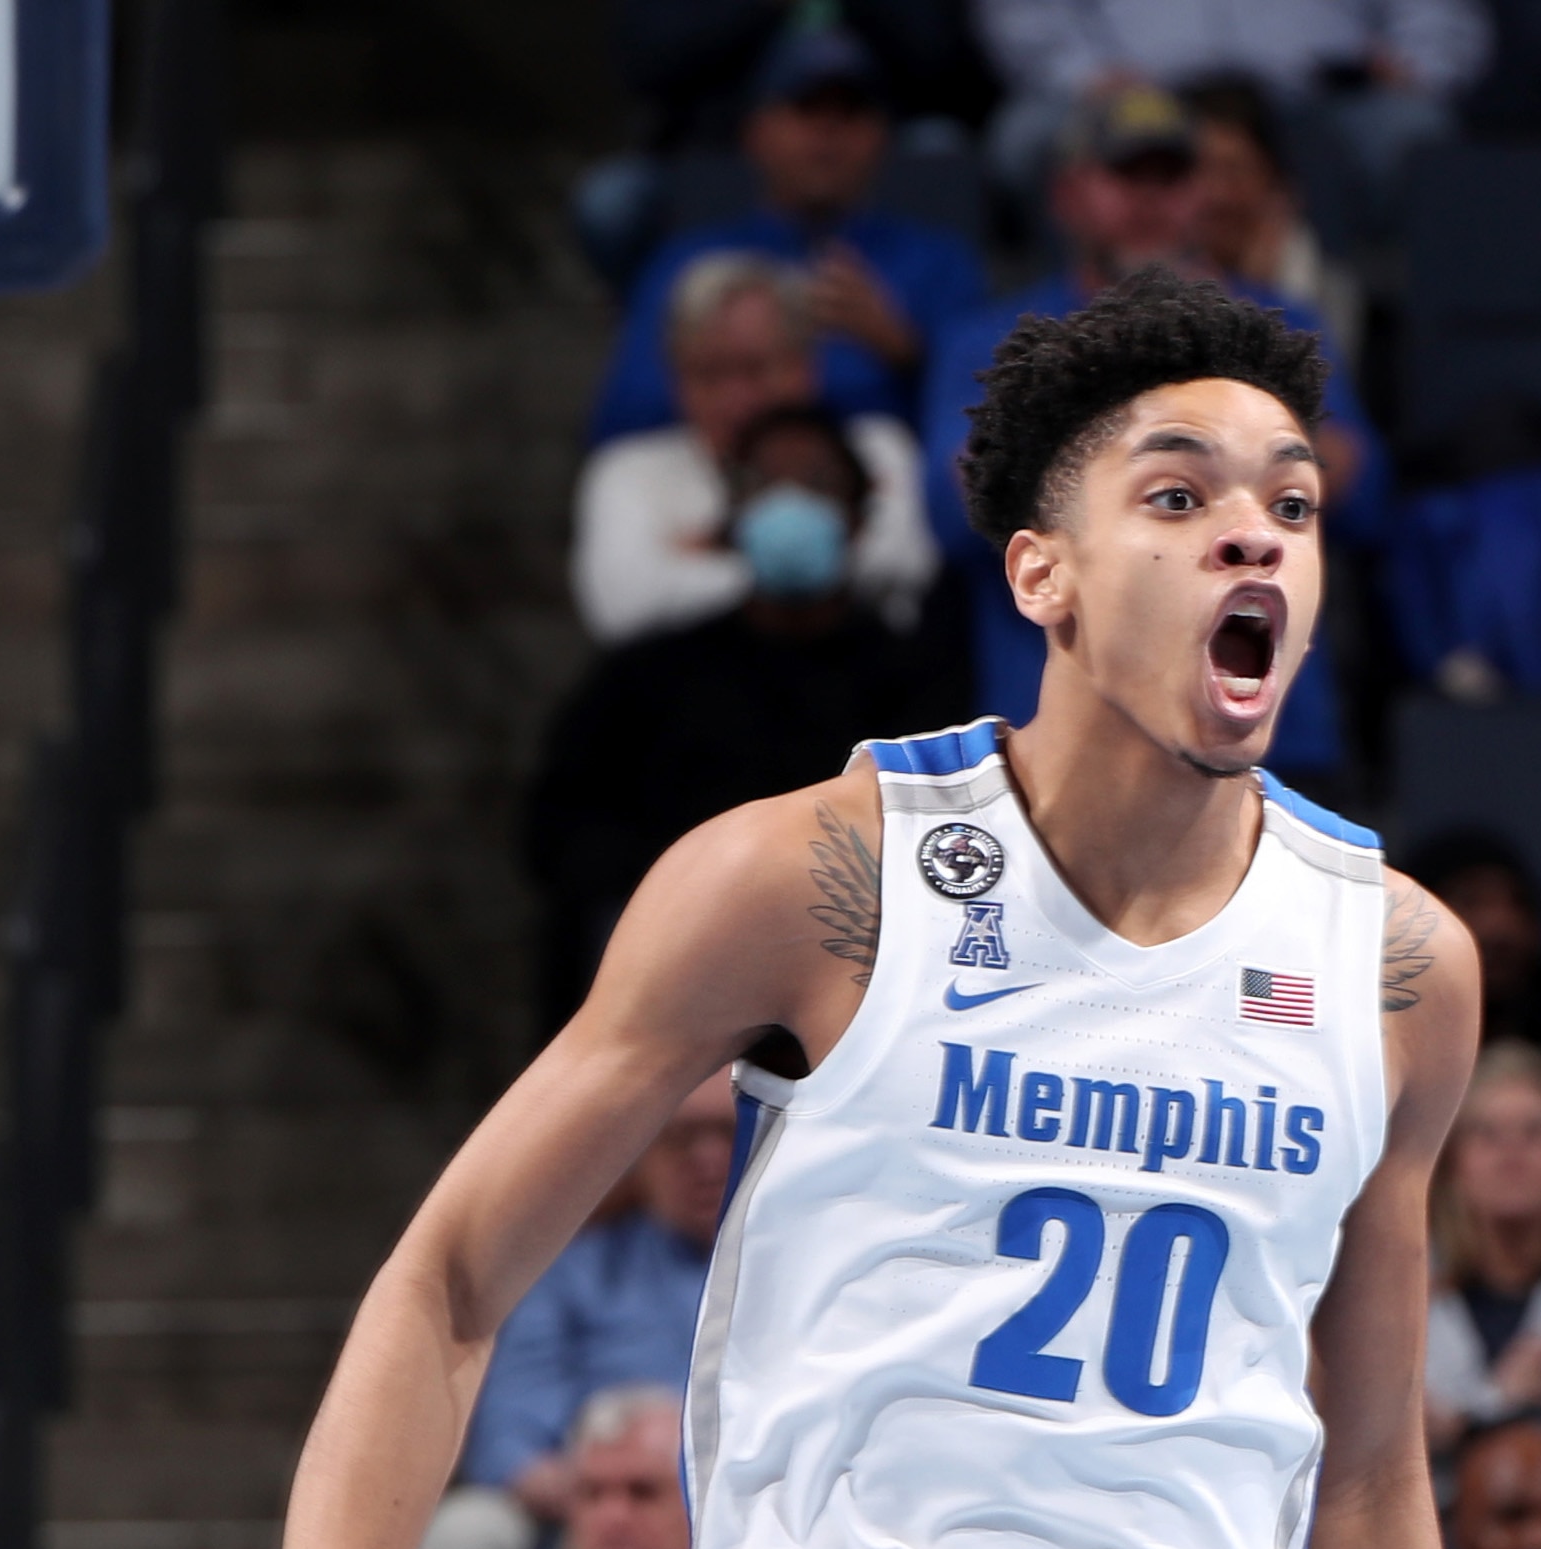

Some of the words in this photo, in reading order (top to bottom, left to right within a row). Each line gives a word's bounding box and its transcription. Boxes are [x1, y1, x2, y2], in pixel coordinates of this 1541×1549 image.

[948, 900, 1011, 970] A
[928, 1040, 1325, 1176] Memphis
[967, 1186, 1230, 1418] 20
